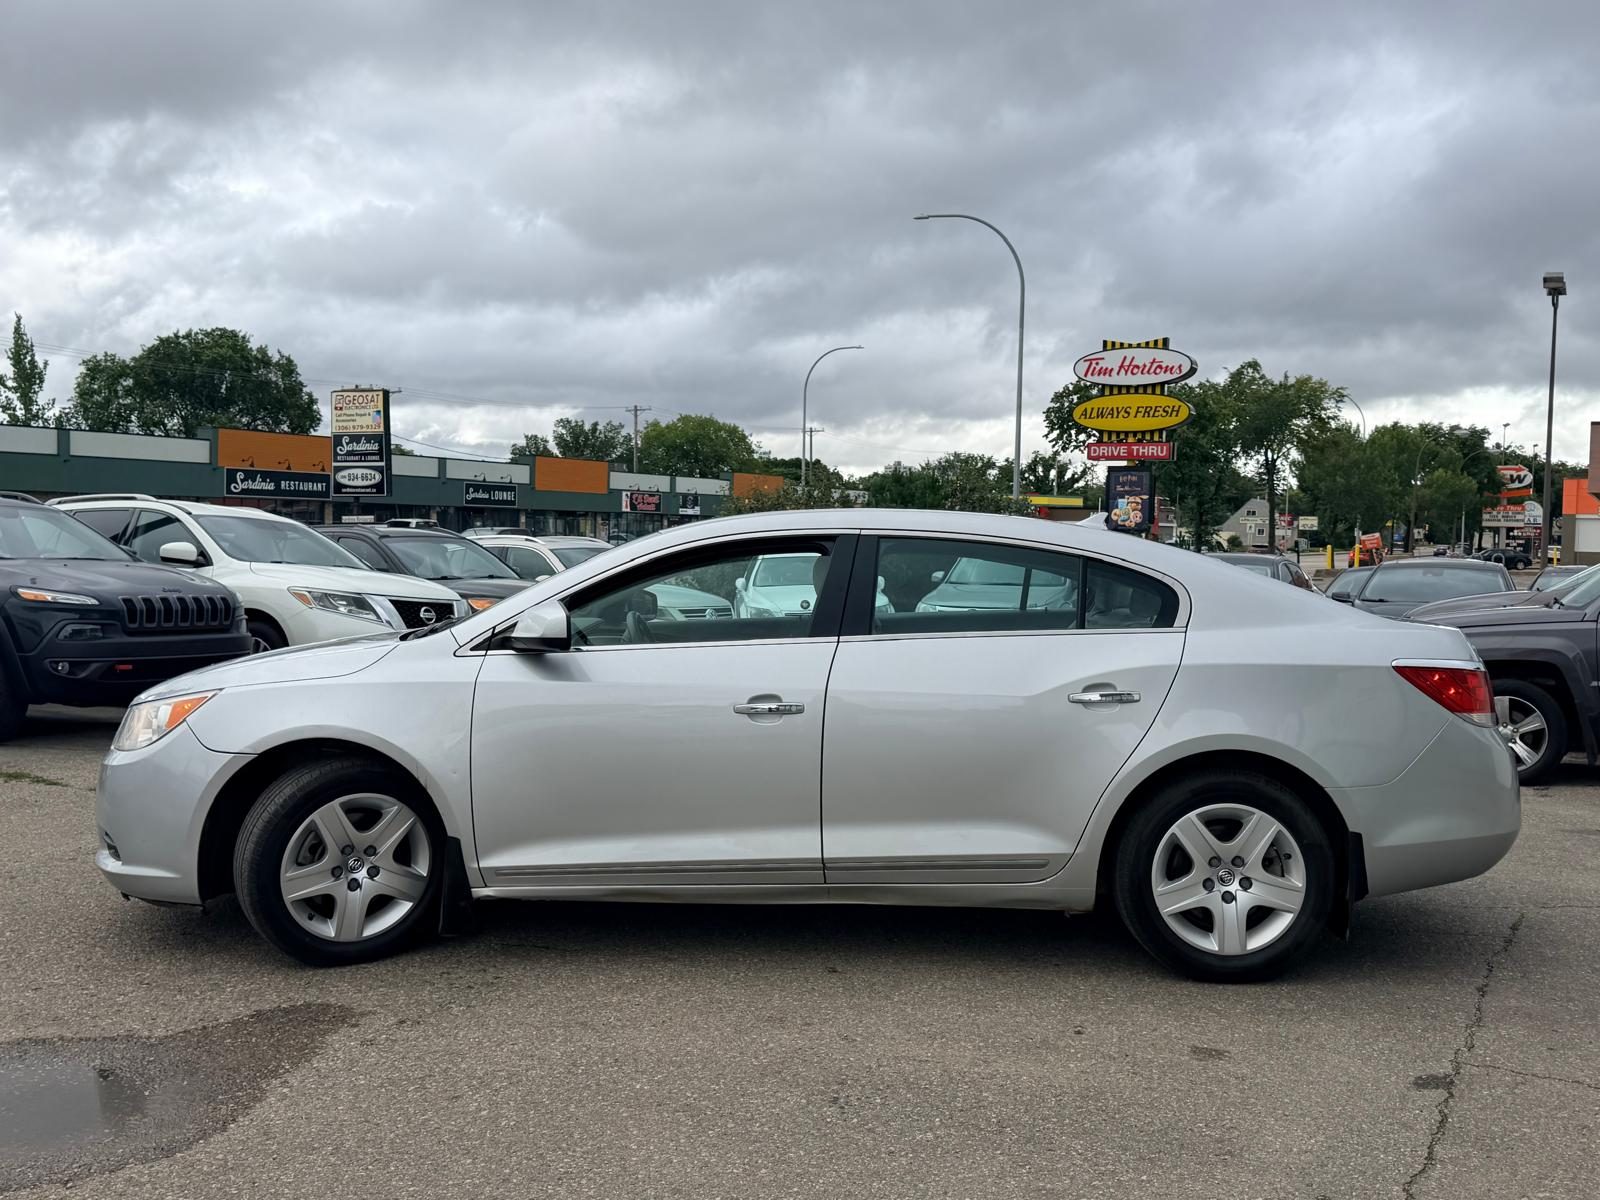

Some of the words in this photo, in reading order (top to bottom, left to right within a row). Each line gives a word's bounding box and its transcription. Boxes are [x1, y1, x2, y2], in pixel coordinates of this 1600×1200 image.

[1083, 357, 1113, 378] Tim
[1116, 355, 1183, 376] Hortons
[344, 393, 380, 405] GEOSAT
[1078, 406, 1132, 419] ALWAYS
[1133, 405, 1181, 418] FRESH
[336, 436, 380, 454] Sardinia
[1090, 446, 1128, 457] DRIVE
[1132, 446, 1167, 456] THRU
[230, 472, 275, 492] Sardinia
[280, 480, 327, 492] RESTAURANT
[347, 472, 376, 482] 934-6634
[490, 490, 515, 501] LOUNGE
